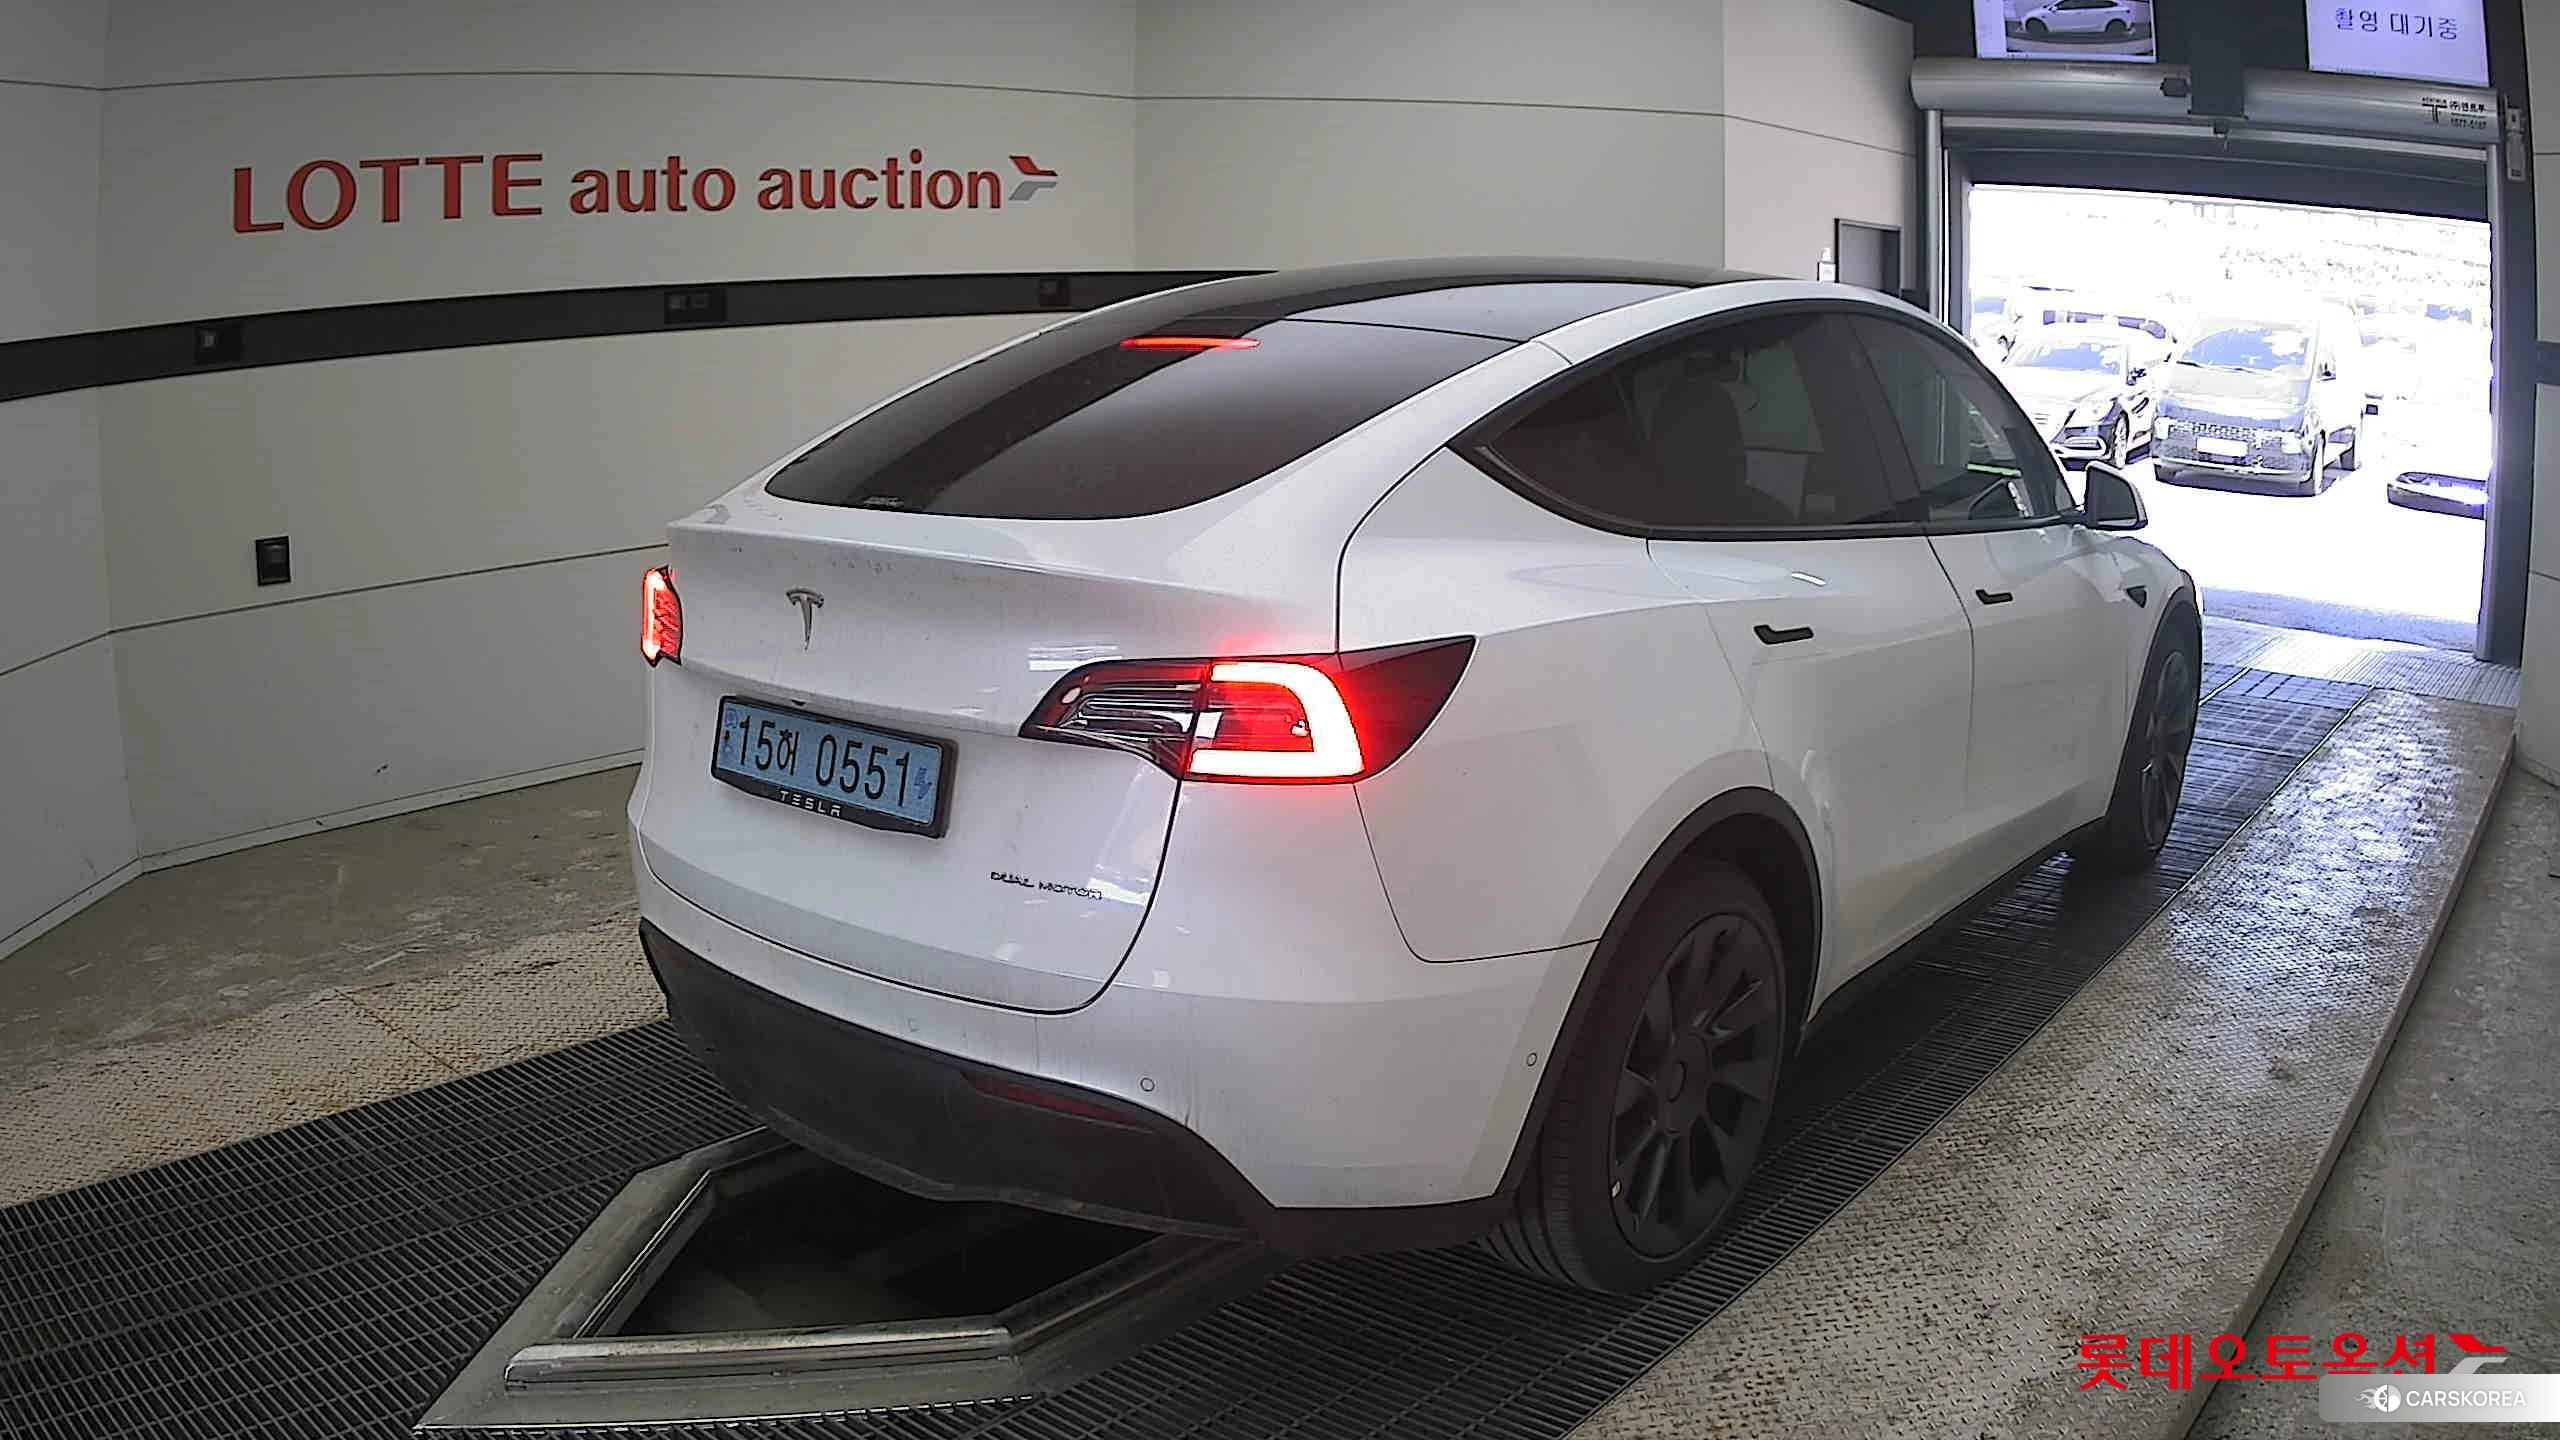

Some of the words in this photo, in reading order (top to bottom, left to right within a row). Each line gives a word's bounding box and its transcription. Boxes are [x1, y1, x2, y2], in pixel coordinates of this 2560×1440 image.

[2335, 8, 2378, 33] 촬영
[2390, 13, 2457, 40] 대기중
[234, 153, 543, 234] LOTTE
[569, 155, 736, 214] auto
[757, 148, 1002, 212] auction
[740, 715, 799, 776] 15허
[816, 734, 910, 807] 0551
[780, 790, 841, 817] TESLA
